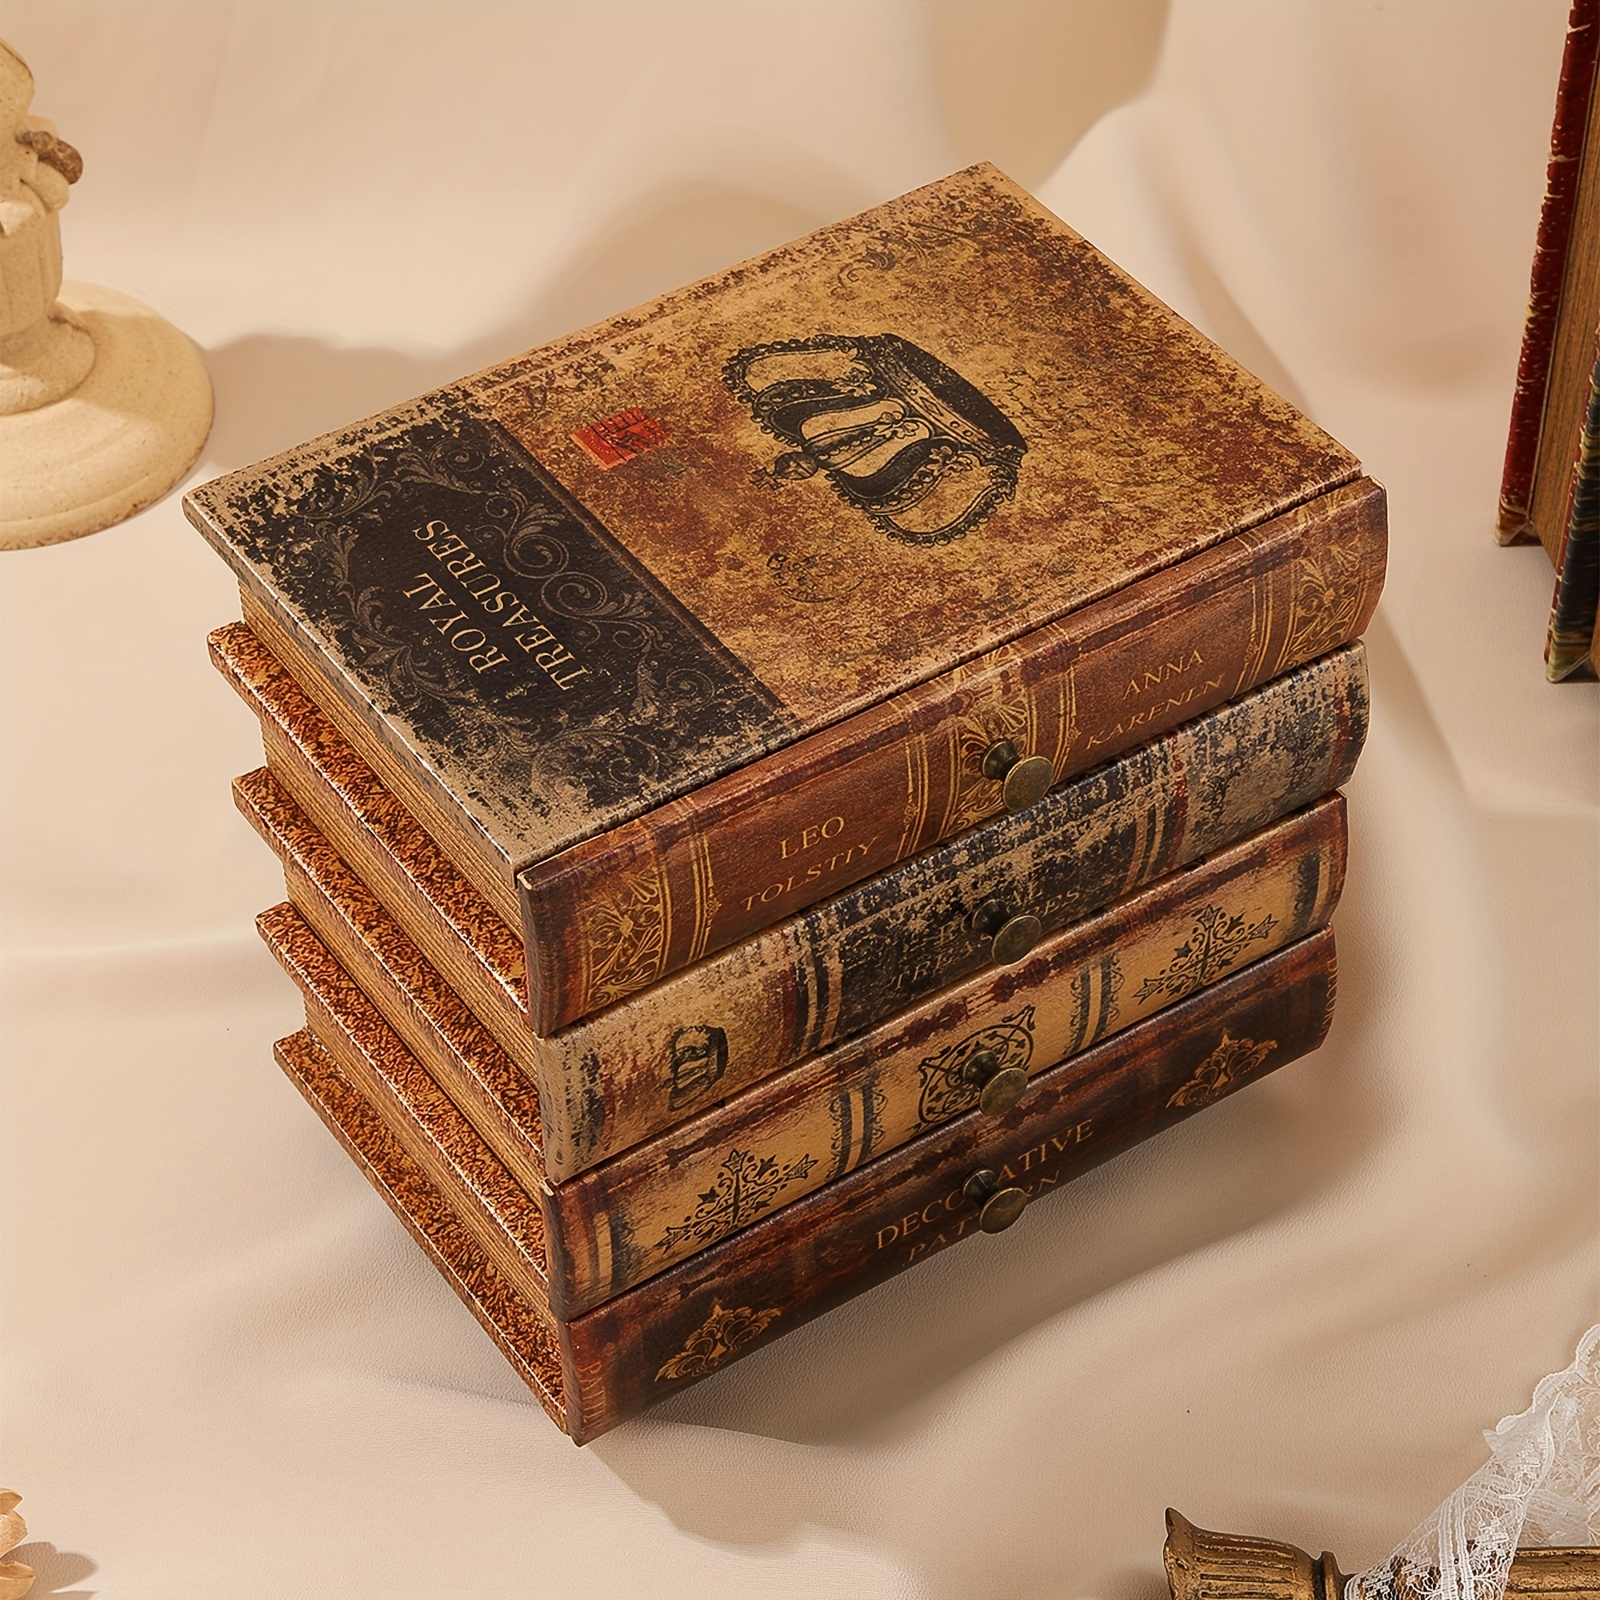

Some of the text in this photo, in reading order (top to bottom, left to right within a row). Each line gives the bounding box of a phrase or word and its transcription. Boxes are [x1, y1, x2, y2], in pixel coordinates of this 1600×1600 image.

[402, 573, 510, 675] ROYAL
[413, 519, 589, 692] TREASURES
[1122, 650, 1204, 700] ANNA
[740, 836, 878, 911] TOLSTIY
[780, 816, 845, 859] LEO
[876, 1118, 1094, 1250] DECOATIVE
